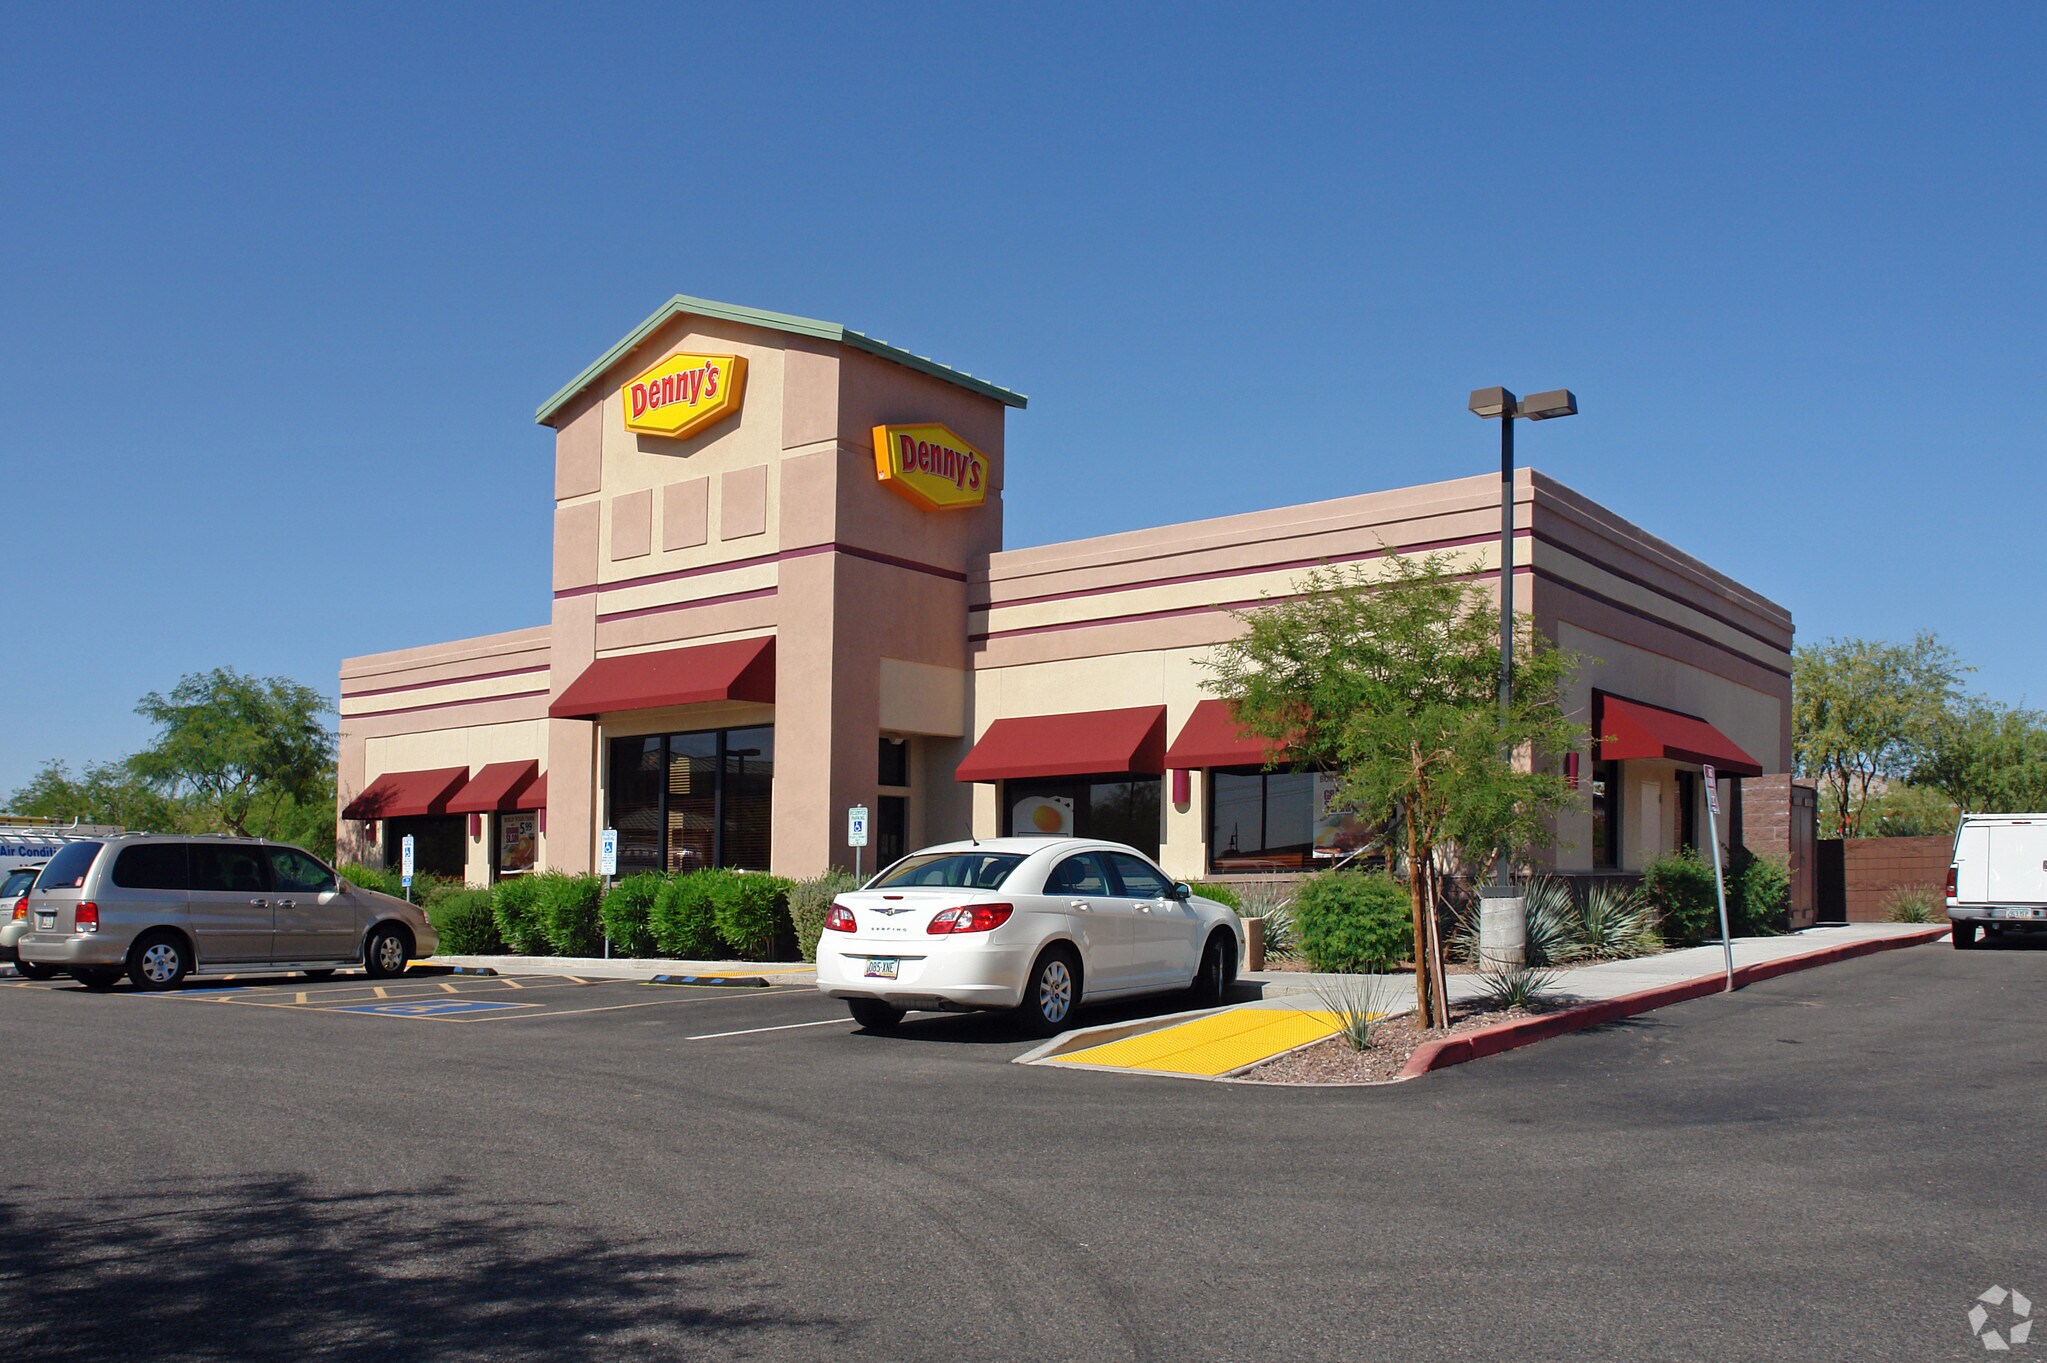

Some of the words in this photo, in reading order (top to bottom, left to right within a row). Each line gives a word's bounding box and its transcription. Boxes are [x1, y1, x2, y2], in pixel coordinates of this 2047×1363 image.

[630, 359, 720, 420] Denny's
[899, 434, 982, 491] Denny's
[0, 845, 15, 857] Air
